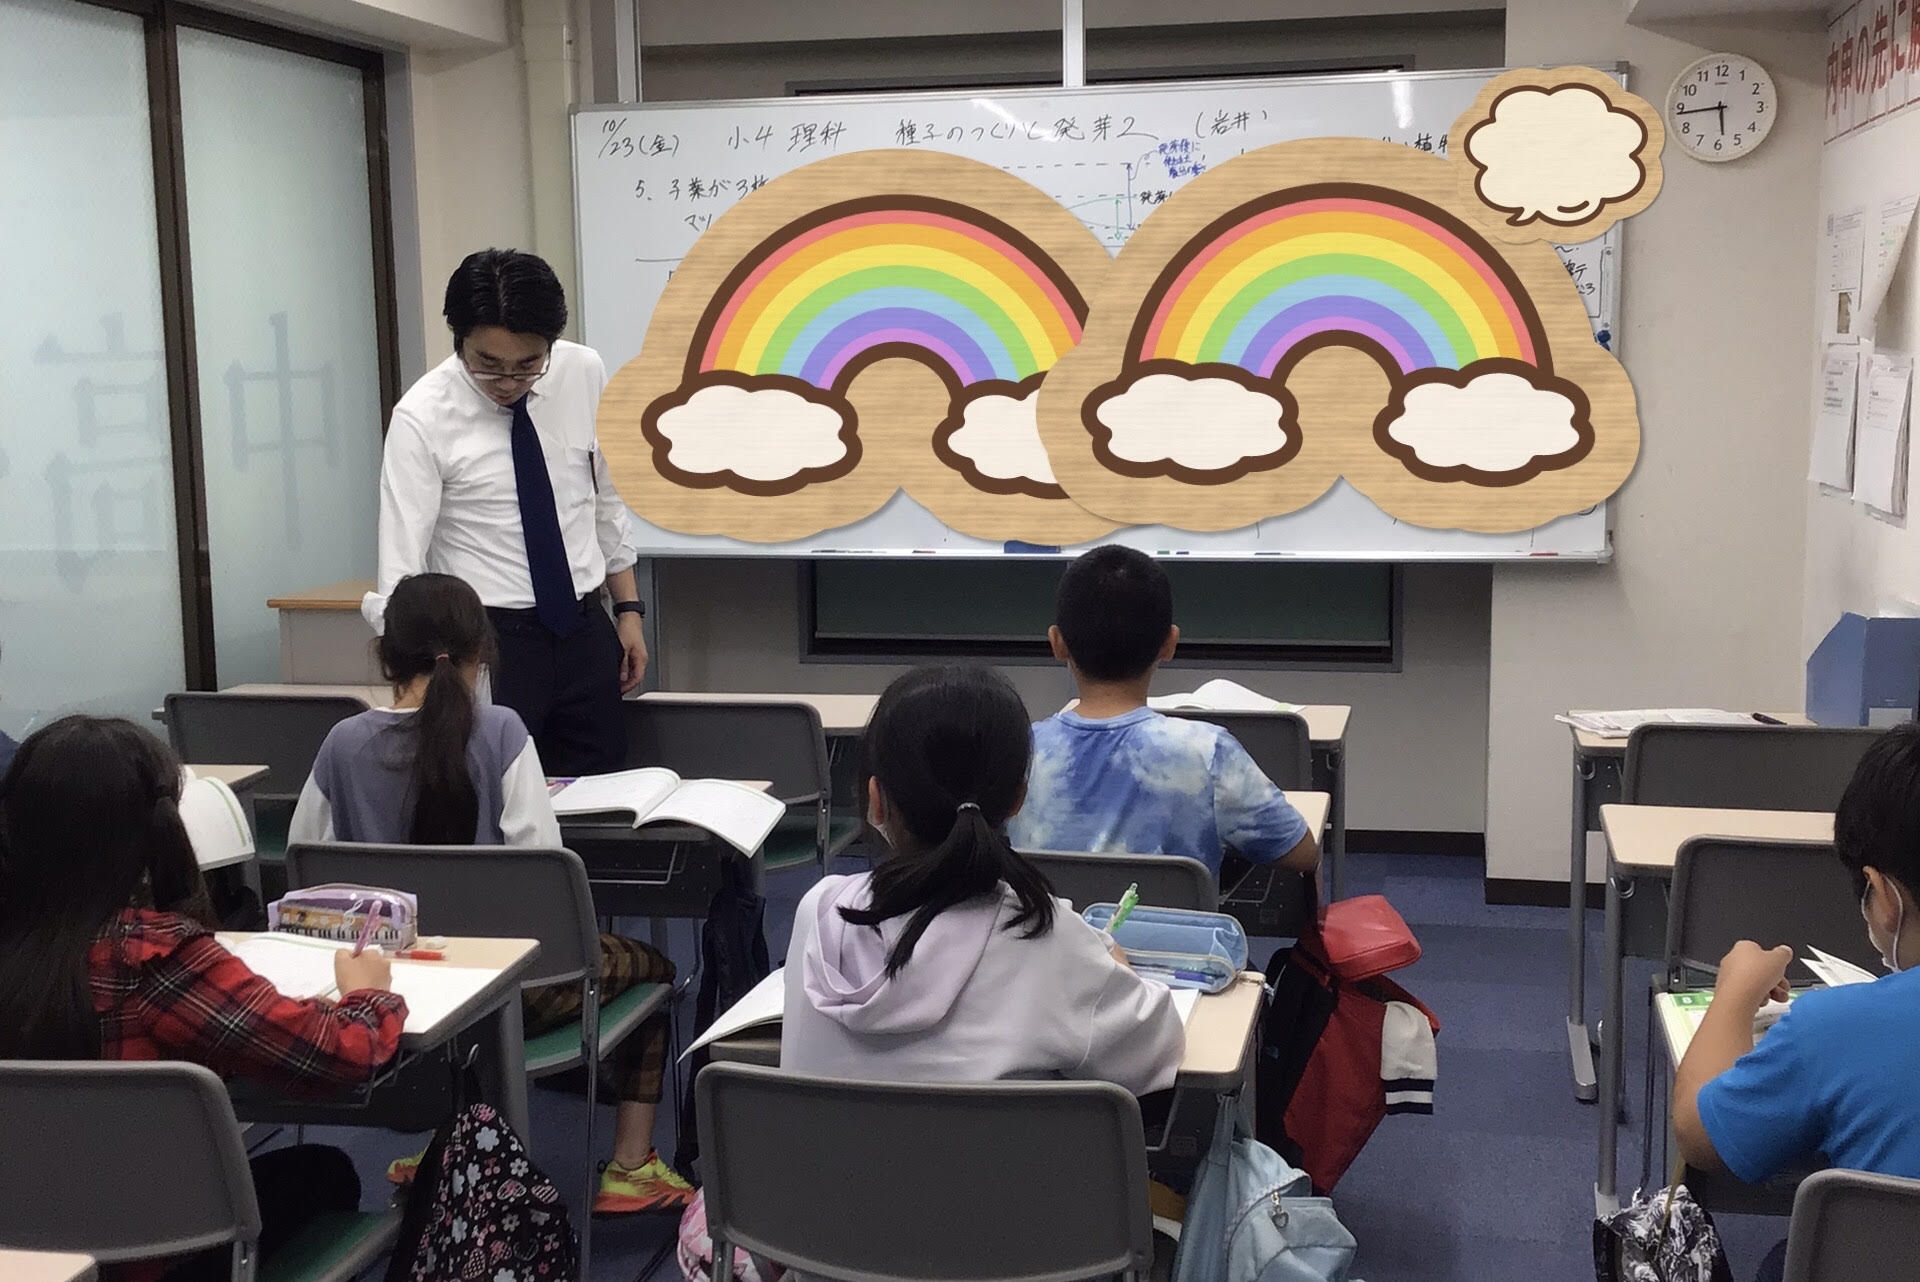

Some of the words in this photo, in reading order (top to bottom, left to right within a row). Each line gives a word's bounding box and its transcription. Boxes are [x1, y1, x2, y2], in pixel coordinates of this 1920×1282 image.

[1697, 70, 1709, 82] 11
[1715, 64, 1729, 77] 12
[1739, 69, 1746, 81] 1
[1682, 83, 1697, 97] 10
[1751, 82, 1760, 95] 2
[1676, 102, 1685, 114] 9
[1756, 101, 1764, 114] 3
[1681, 122, 1690, 134] 8
[1747, 121, 1756, 133] 4
[787, 120, 847, 153] 理科
[1696, 134, 1705, 147] 7
[1733, 133, 1742, 146] 5
[1713, 139, 1722, 151] 6
